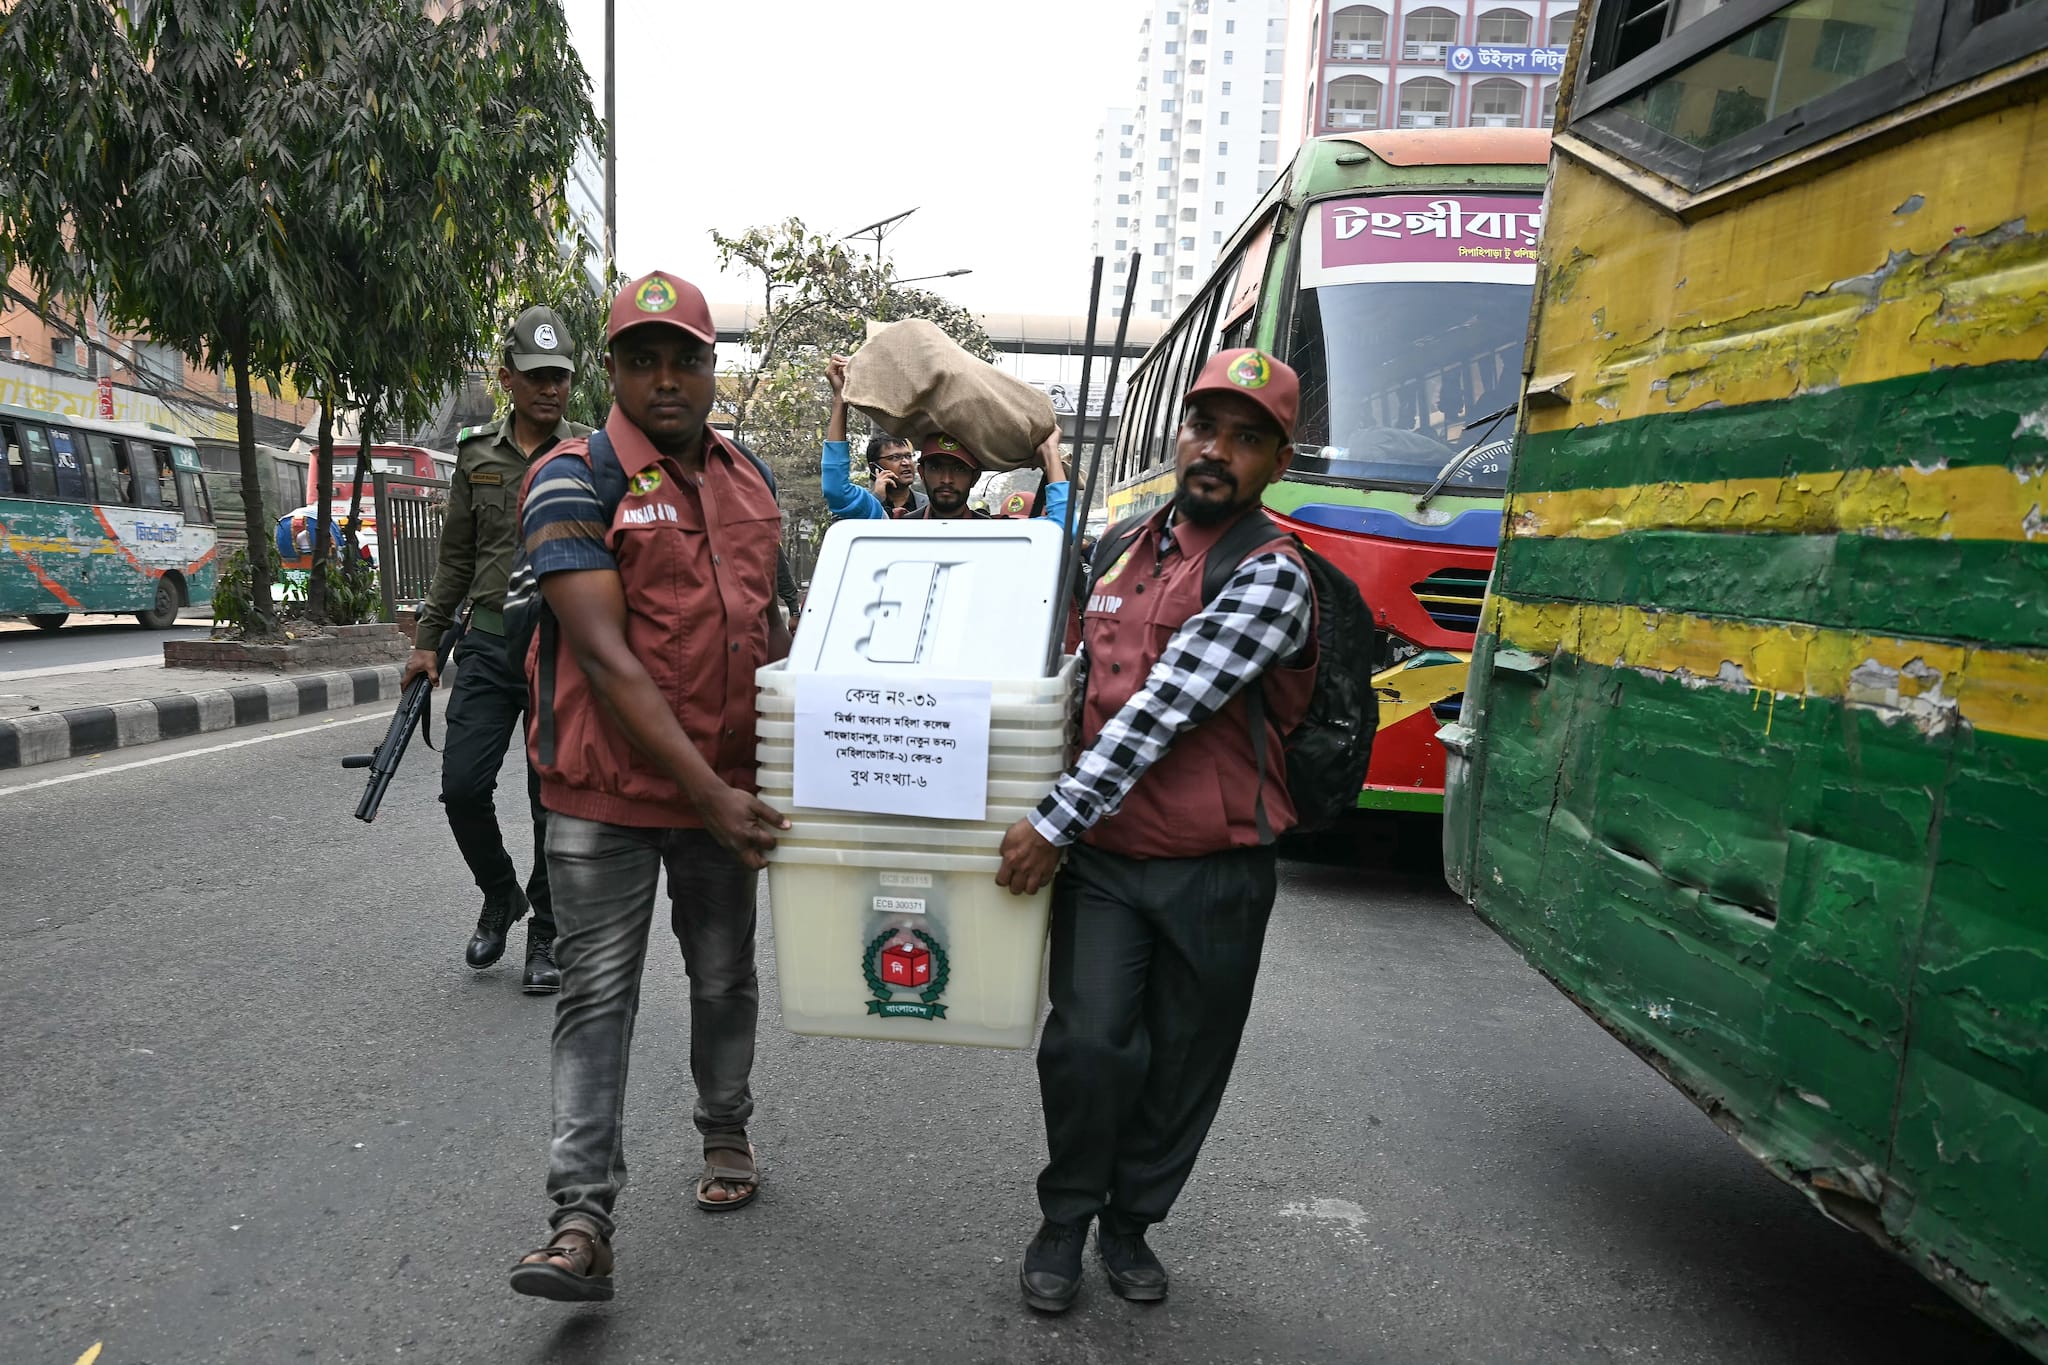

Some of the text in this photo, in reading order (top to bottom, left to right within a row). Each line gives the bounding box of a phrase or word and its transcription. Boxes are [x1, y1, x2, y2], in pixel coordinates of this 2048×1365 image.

[1482, 463, 1498, 473] 20
[623, 504, 656, 523] ANSAR
[845, 688, 937, 707] কেন্দ্র নং-৩৯
[834, 711, 856, 724] মির্জা
[894, 715, 920, 729] মহিলা
[923, 719, 951, 730] কলেজ
[883, 734, 903, 744] ঢাকা
[850, 769, 928, 788] বুথ সংখ্যা-৬
[876, 899, 893, 909] ECB
